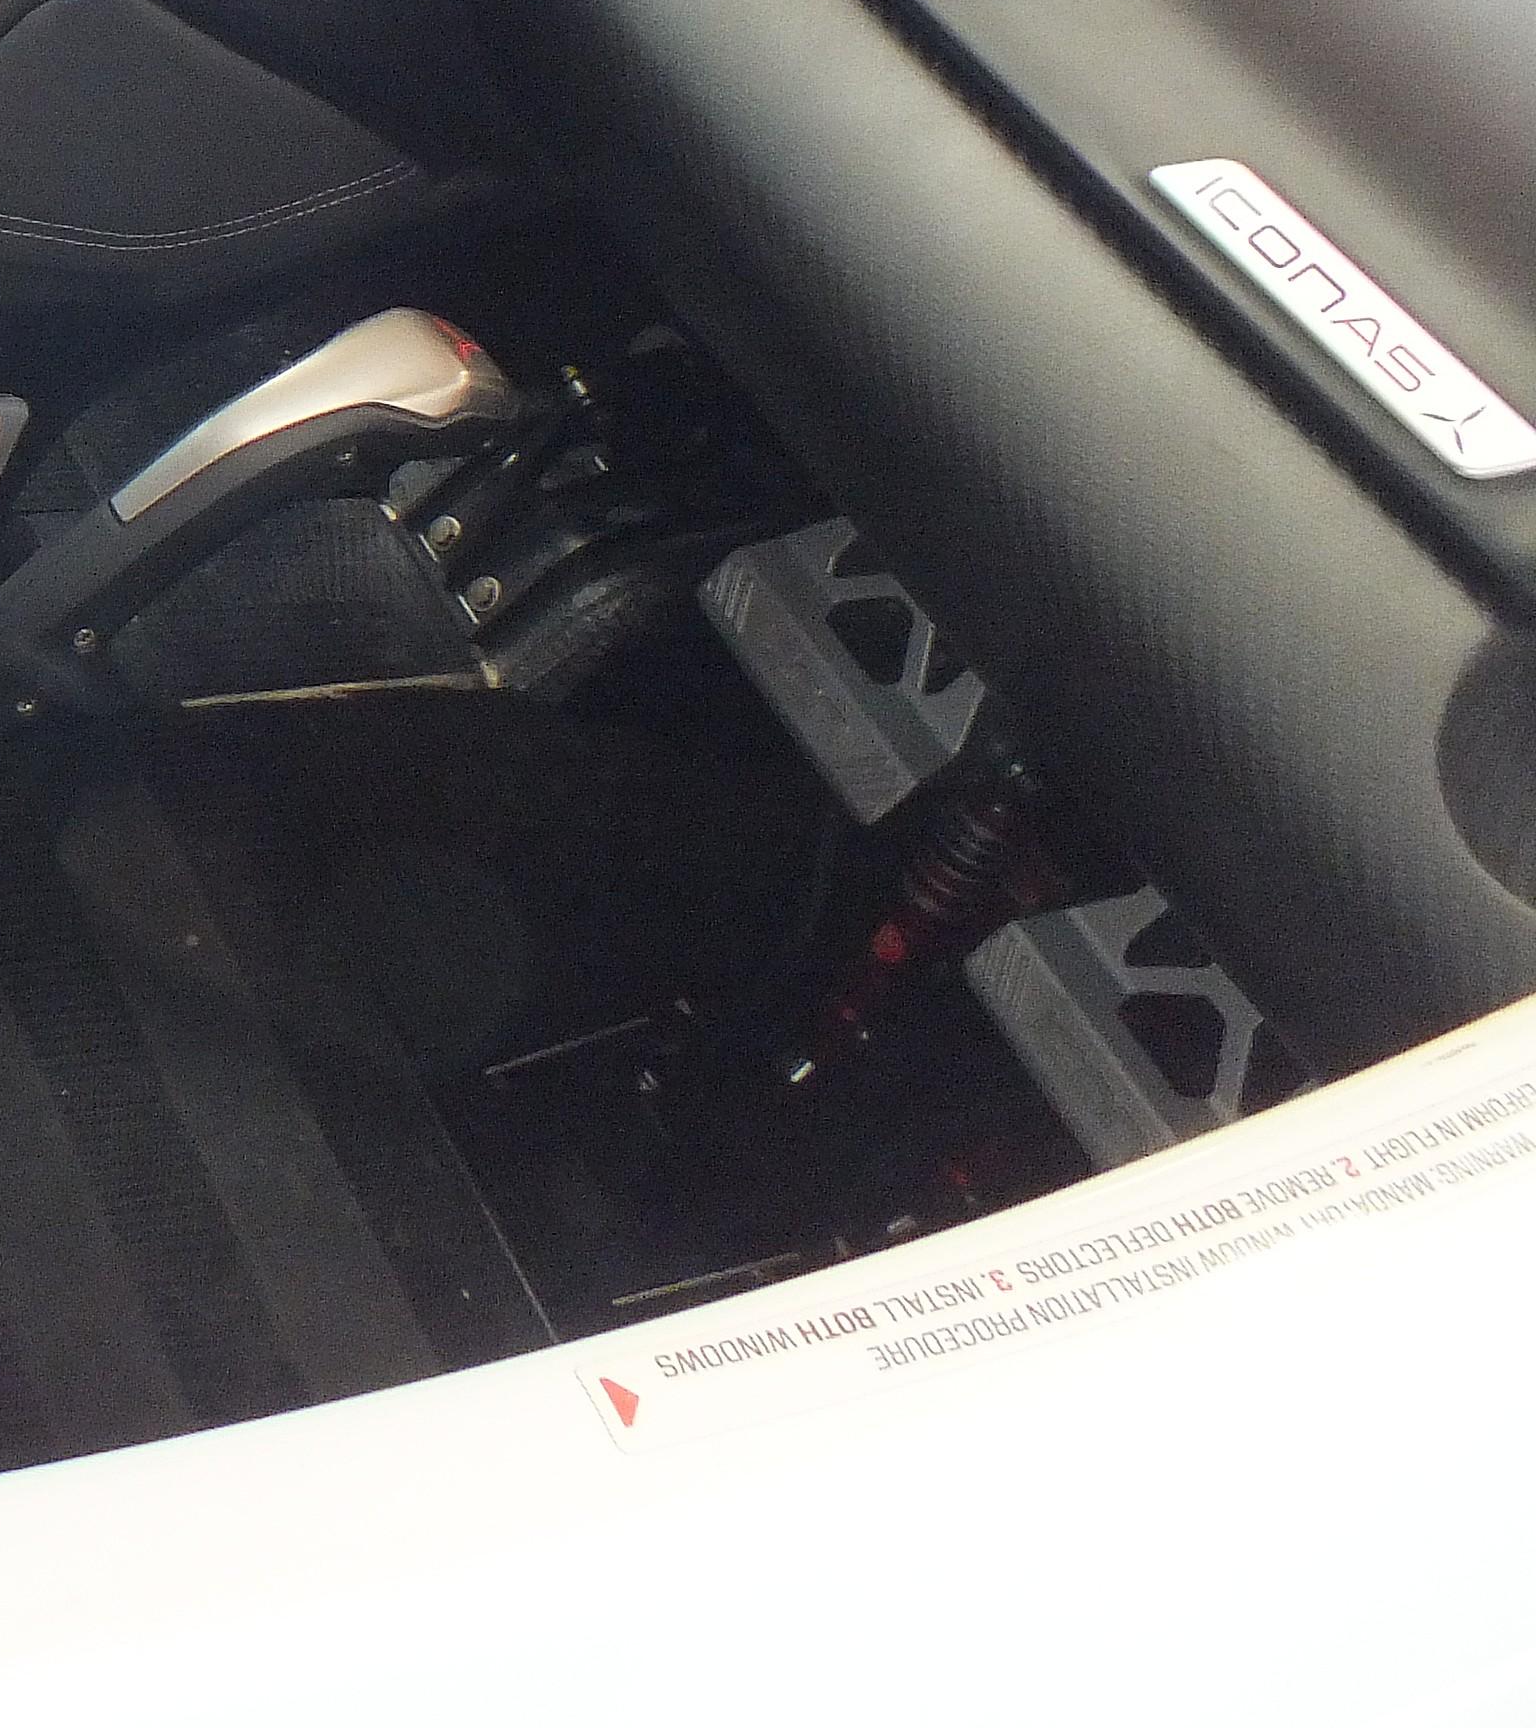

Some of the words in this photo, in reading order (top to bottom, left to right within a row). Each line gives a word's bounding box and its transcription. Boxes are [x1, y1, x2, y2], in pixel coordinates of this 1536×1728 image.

[1195, 176, 1346, 313] ICON
[1332, 317, 1436, 393] A5
[1363, 1130, 1440, 1170] FLIGHT
[1432, 1114, 1464, 1142] IN
[1330, 1156, 1360, 1178] 2.
[1428, 1131, 1536, 1184] WARNING:
[1237, 1164, 1340, 1215] REMOVE
[1171, 1198, 1243, 1237] BOTH
[1016, 1220, 1175, 1284] DEFLECTORS
[873, 1277, 985, 1323] INSTALL
[980, 1268, 1014, 1293] 3.
[1025, 1256, 1200, 1326] INSTALLATION
[795, 1306, 878, 1345] BOTH
[867, 1308, 1029, 1371] PROCEDURE
[654, 1327, 798, 1378] WINDOWS
